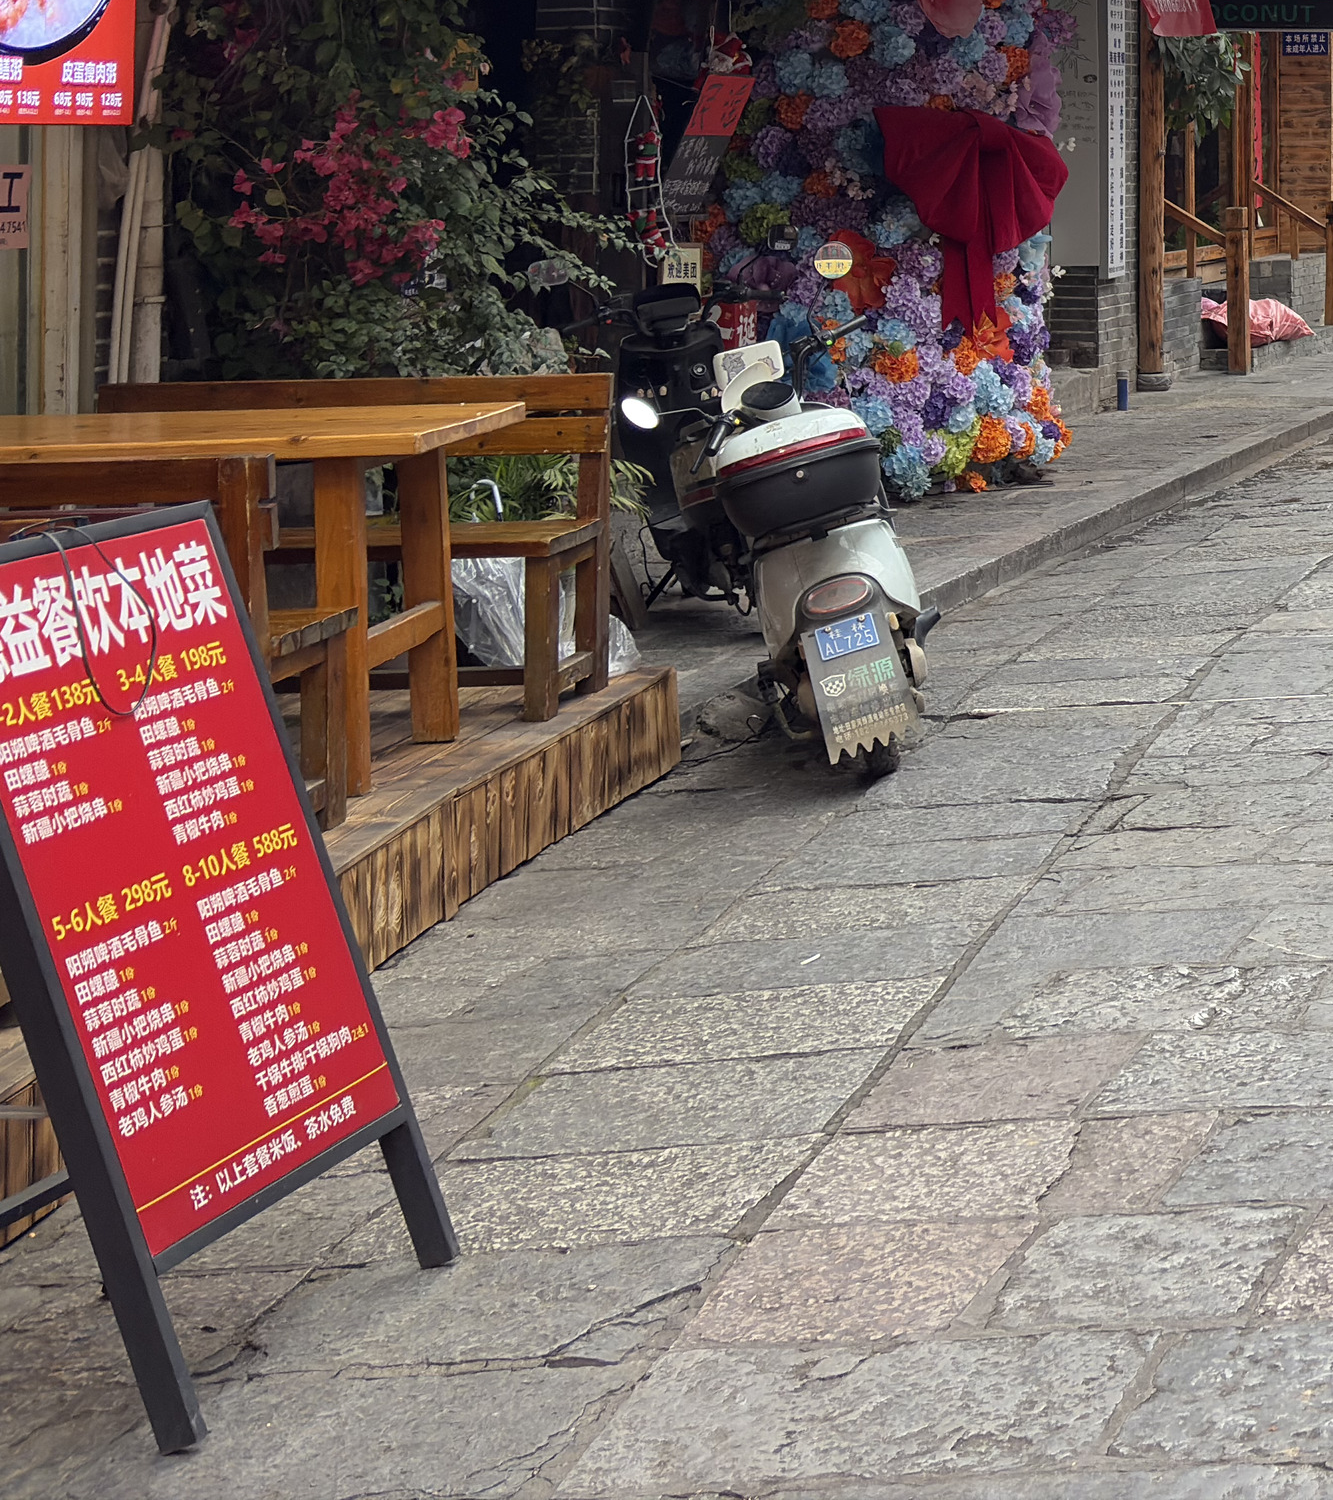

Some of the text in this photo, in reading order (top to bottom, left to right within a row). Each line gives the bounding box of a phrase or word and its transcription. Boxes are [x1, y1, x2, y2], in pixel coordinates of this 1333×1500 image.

[62, 61, 117, 84] 皮蛋瘦肉粥
[17, 90, 122, 108] 138元 68元 98元 128元
[667, 261, 697, 279] 欢迎美团
[825, 629, 874, 657] AL725
[828, 621, 866, 640] 桂林
[180, 640, 227, 674] 198元
[847, 656, 896, 688] 绿源
[146, 736, 202, 771] 蒜蓉时蔬
[155, 752, 233, 796] 新疆小把烧串
[12, 780, 74, 819] 蒜蓉时蔬
[163, 776, 241, 821] 西红柿炒鸡蛋
[20, 797, 108, 845] 新疆小把烧串
[171, 810, 225, 846] 青椒牛肉
[182, 822, 298, 888] 8-10人餐 588元
[51, 872, 172, 941] 5-6人餐 298元
[196, 867, 284, 920] 阳朔啤酒毛骨鱼
[65, 920, 164, 980] 阳朔啤酒毛骨鱼
[213, 930, 265, 970] 蒜蓉时蔬
[221, 943, 296, 994] 新疆小把烧串
[82, 988, 142, 1032] 蒜蓉时蔬
[229, 966, 305, 1020] 西红柿炒鸡蛋
[91, 1002, 176, 1059] 新疆小把烧串
[237, 1002, 290, 1045] 青椒牛肉
[247, 1020, 309, 1068] 老鸡人参汤
[100, 1027, 185, 1087] 西红柿炒鸡蛋
[108, 1067, 167, 1113] 青椒牛肉
[118, 1084, 189, 1138] 老鸡人参汤
